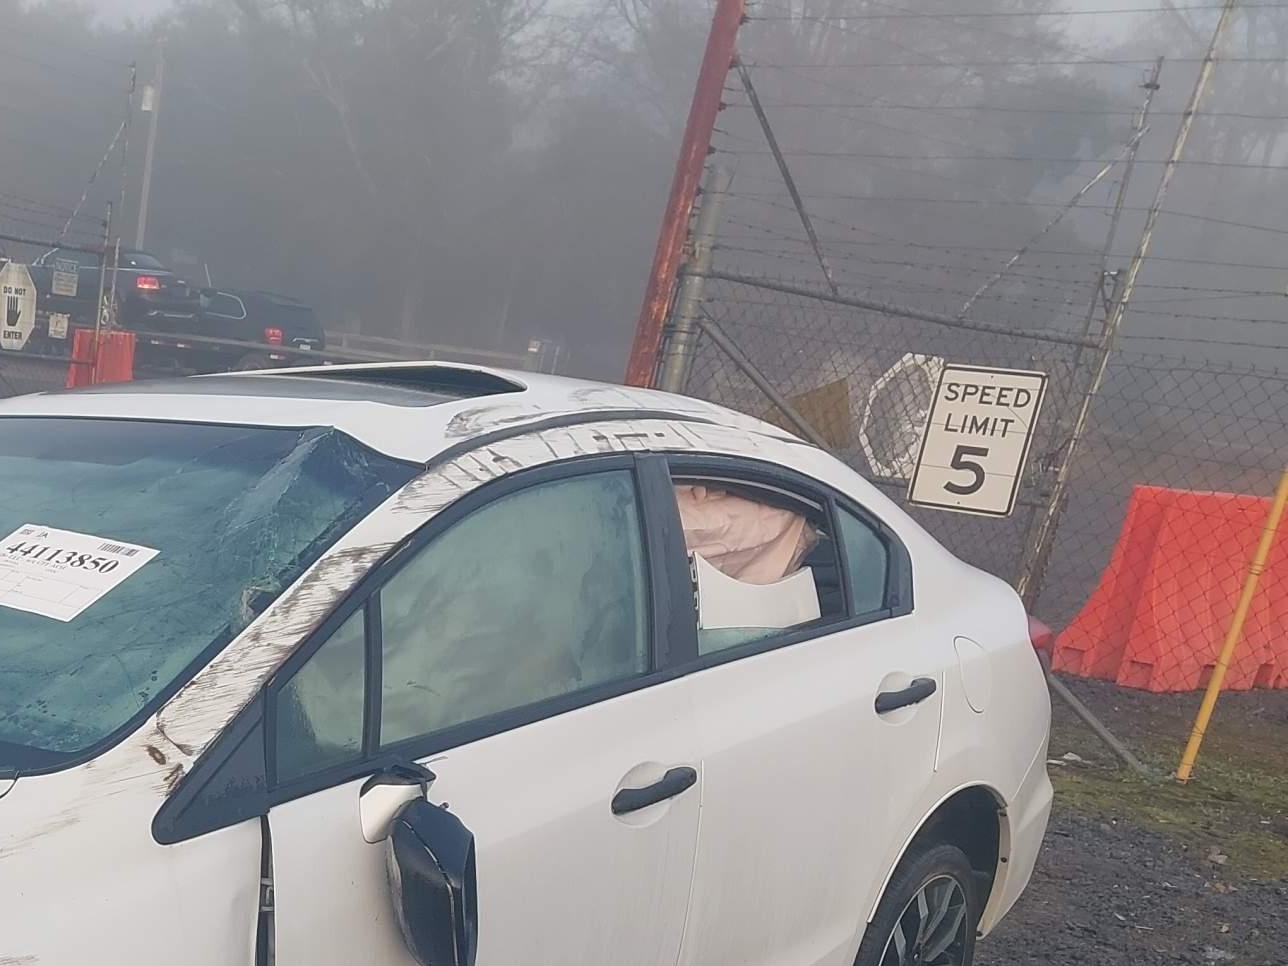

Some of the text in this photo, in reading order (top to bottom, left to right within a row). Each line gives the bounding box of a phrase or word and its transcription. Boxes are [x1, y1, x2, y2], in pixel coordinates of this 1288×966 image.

[3, 286, 27, 296] DO NOT
[3, 330, 22, 340] ENTER
[944, 382, 1032, 408] SPEED
[944, 413, 1015, 438] LIMIT
[943, 445, 990, 495] 5
[6, 541, 120, 574] 44113850
